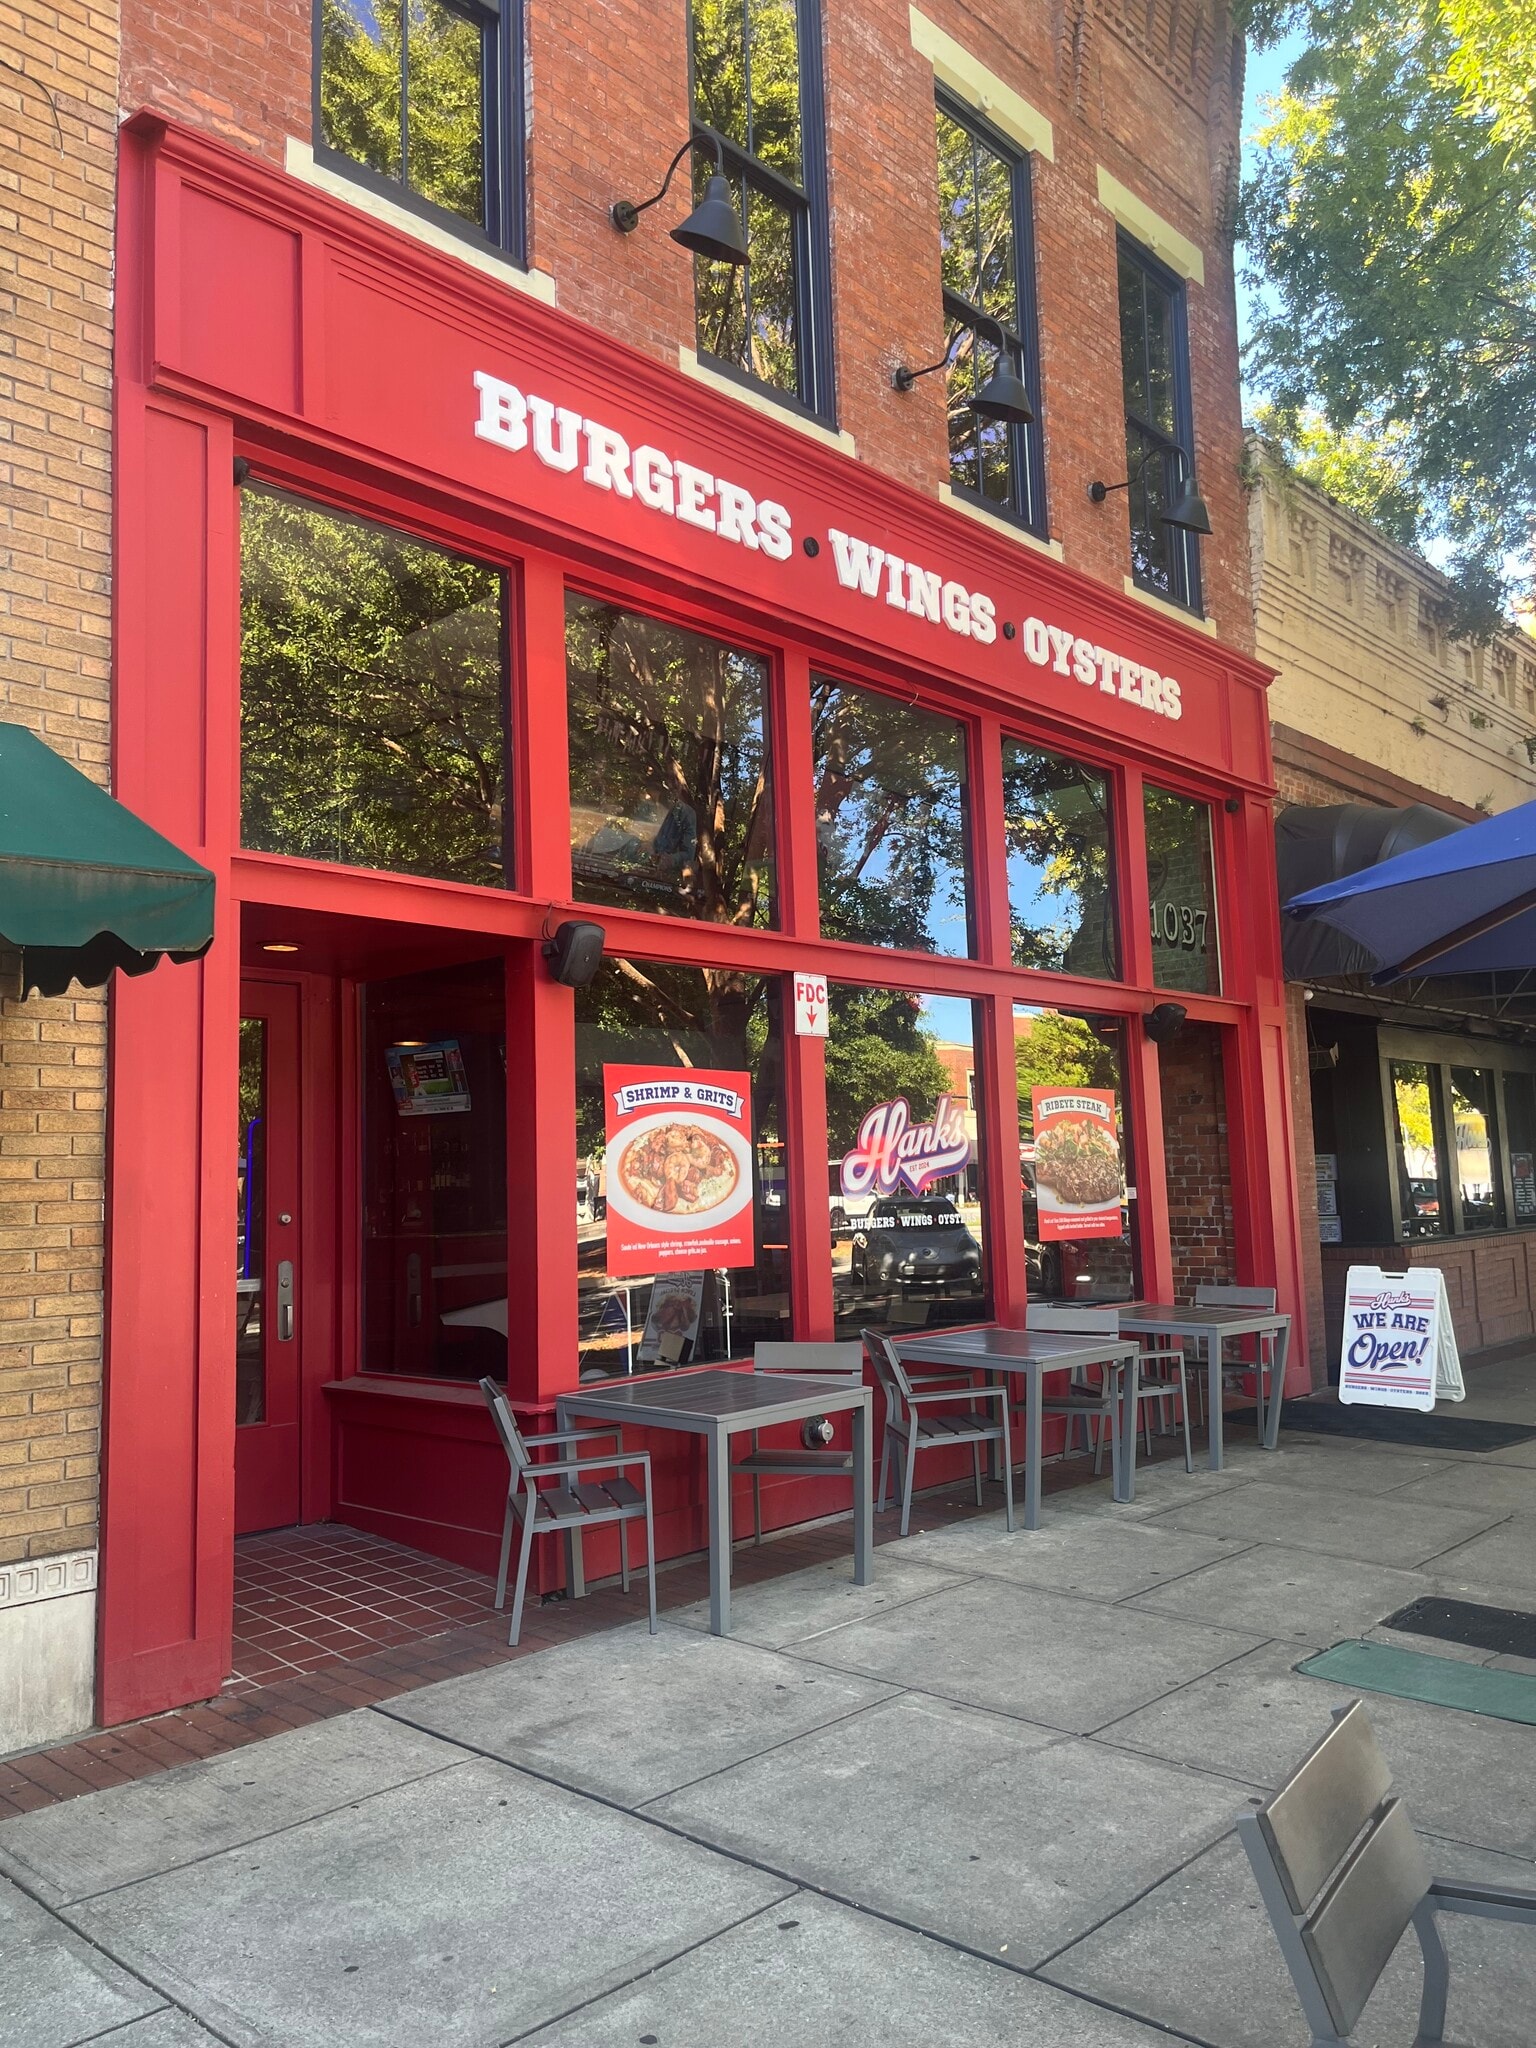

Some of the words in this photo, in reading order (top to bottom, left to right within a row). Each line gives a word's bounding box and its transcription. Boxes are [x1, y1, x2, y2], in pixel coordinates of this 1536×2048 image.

[472, 370, 793, 562] BURGERS
[828, 527, 997, 646] WINGS
[1023, 615, 1183, 721] OYSTERS
[1149, 899, 1208, 949] 1037
[796, 982, 826, 1004] FDC
[626, 1086, 680, 1103] SHRIMP
[684, 1087, 692, 1098] &
[697, 1088, 734, 1107] GRITS
[1045, 1099, 1074, 1112] RIBEYE
[1076, 1099, 1102, 1113] STEAK
[841, 1095, 970, 1197] Hank's
[850, 1216, 895, 1230] BURGERS
[900, 1214, 933, 1227] WINGS
[1370, 1290, 1412, 1311] Hank's
[1353, 1312, 1387, 1329] WE
[1391, 1312, 1430, 1333] ARE
[1347, 1332, 1431, 1370] Open!
